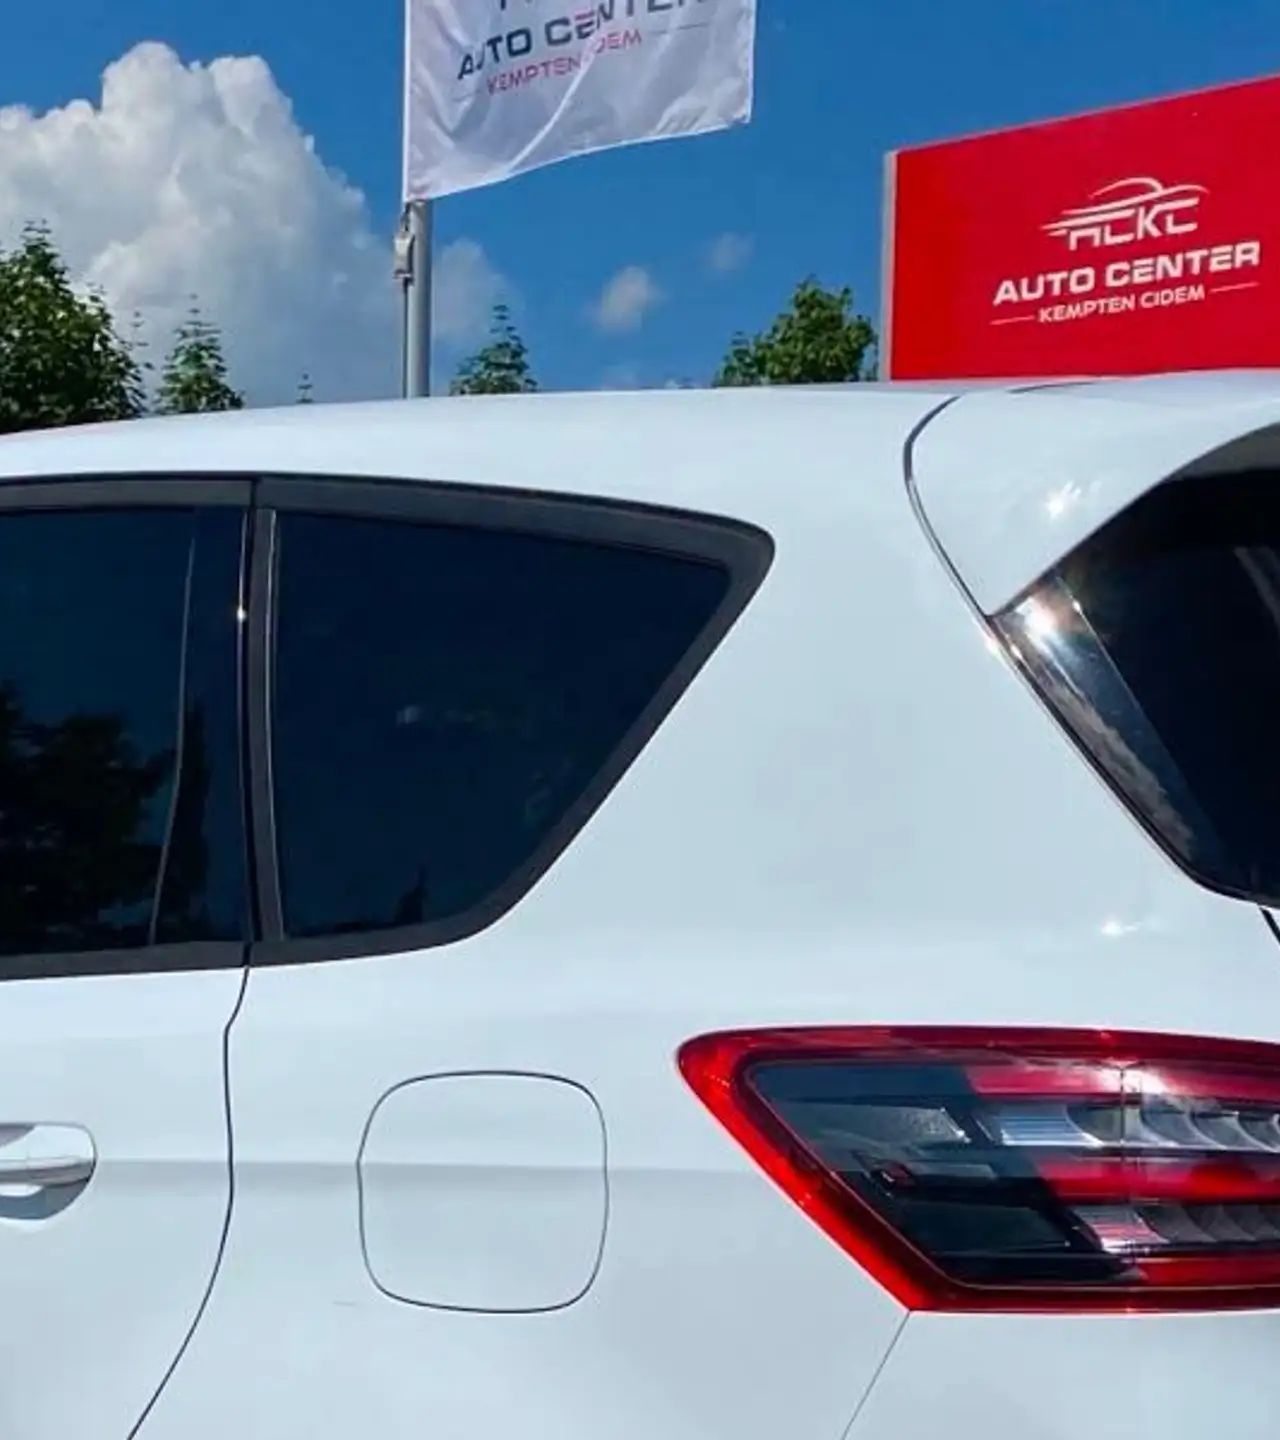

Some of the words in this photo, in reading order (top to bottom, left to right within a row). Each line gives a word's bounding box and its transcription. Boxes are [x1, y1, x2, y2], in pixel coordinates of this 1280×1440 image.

[992, 266, 1096, 306] AUTO
[1105, 241, 1261, 288] CENTER
[1038, 294, 1136, 323] KEMPTEN
[1141, 284, 1206, 309] CIDEM
